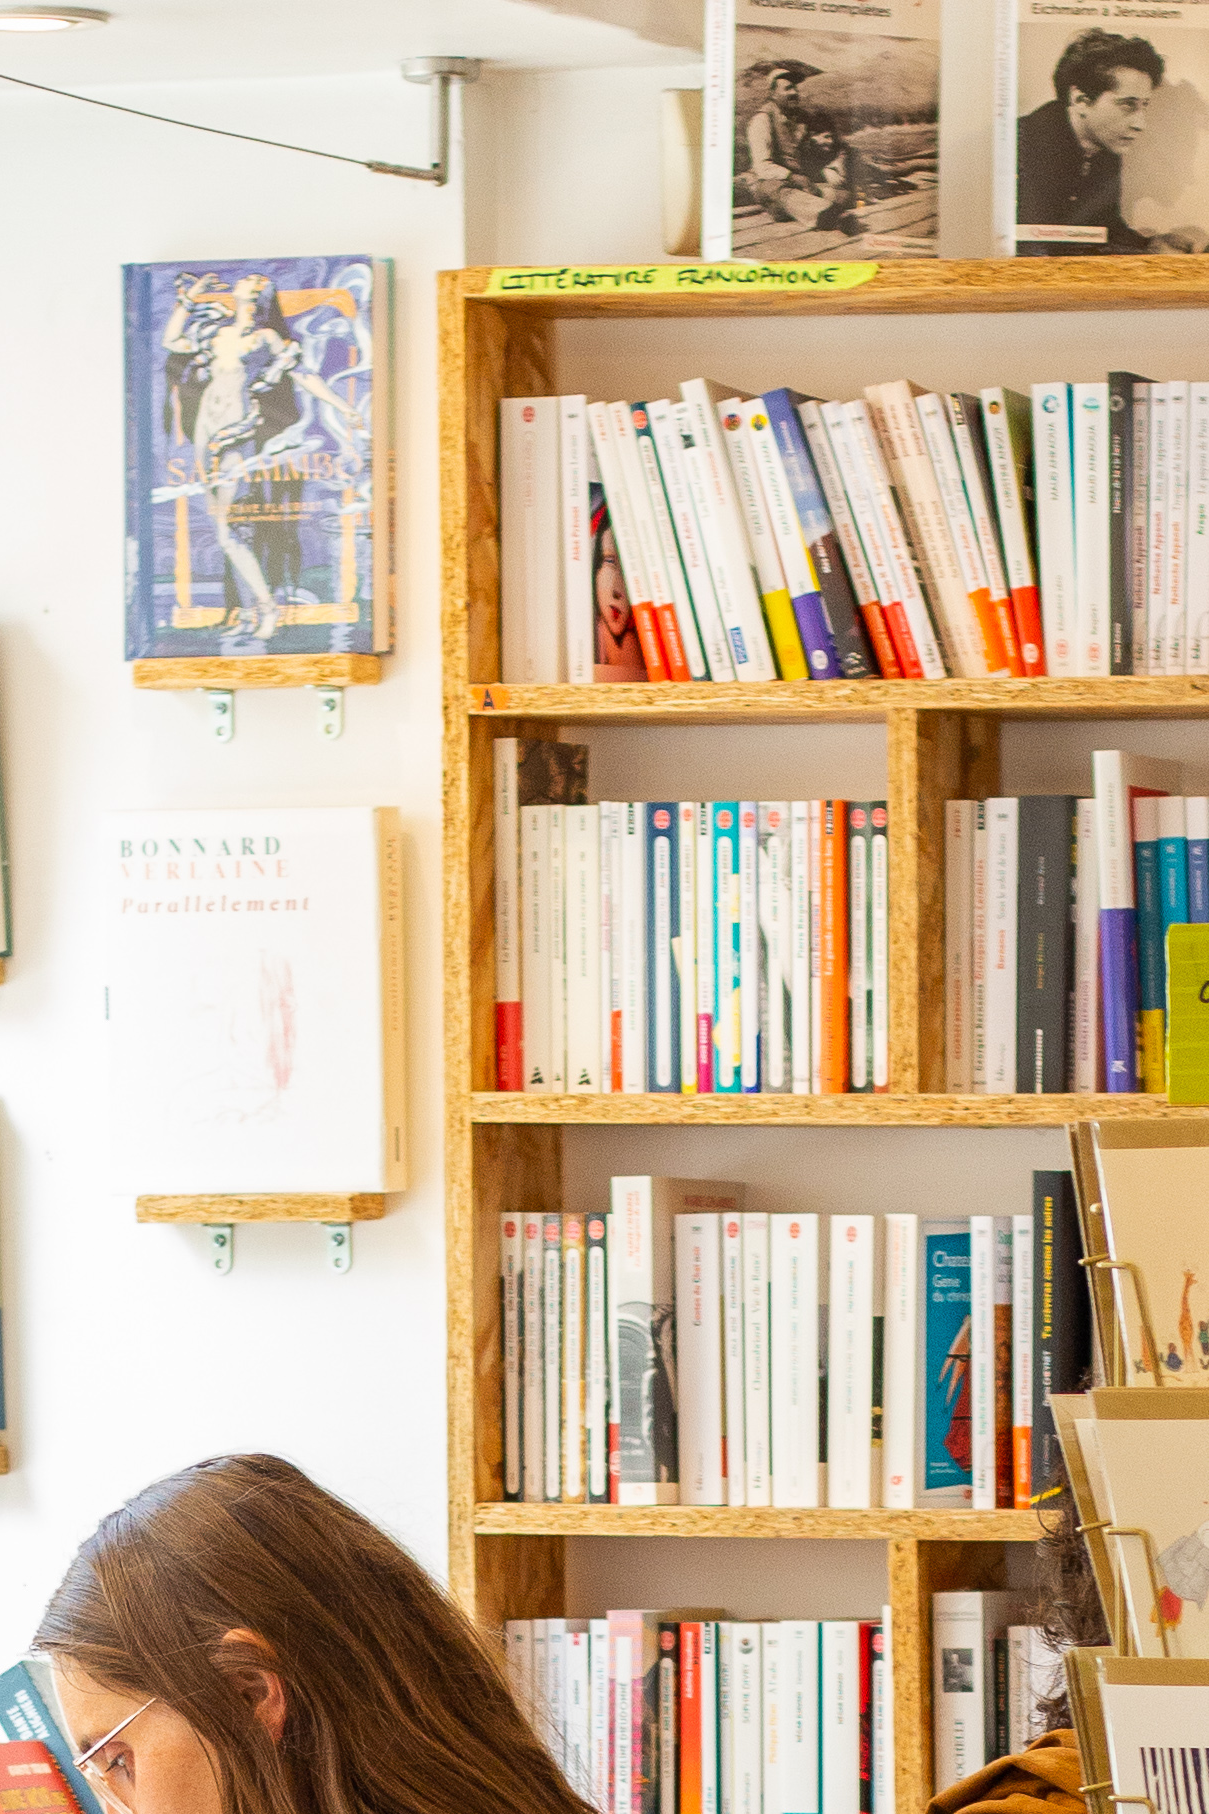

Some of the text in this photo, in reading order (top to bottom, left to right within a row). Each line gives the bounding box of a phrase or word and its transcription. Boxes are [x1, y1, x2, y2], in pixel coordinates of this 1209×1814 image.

[811, 2, 892, 18] complètes
[1031, 2, 1183, 20] Eichmann à Jérusalem
[500, 266, 840, 290] LITTÉRATURE FRANCOPHONE
[120, 836, 281, 858] BONNARD
[120, 859, 290, 881] VERLAINE
[122, 895, 310, 914] Parallèlement
[1042, 1196, 1053, 1225] autres
[1042, 1228, 1052, 1243] les
[1042, 1246, 1052, 1280] comme
[692, 1285, 702, 1296] du
[1042, 1325, 1052, 1339] Tu
